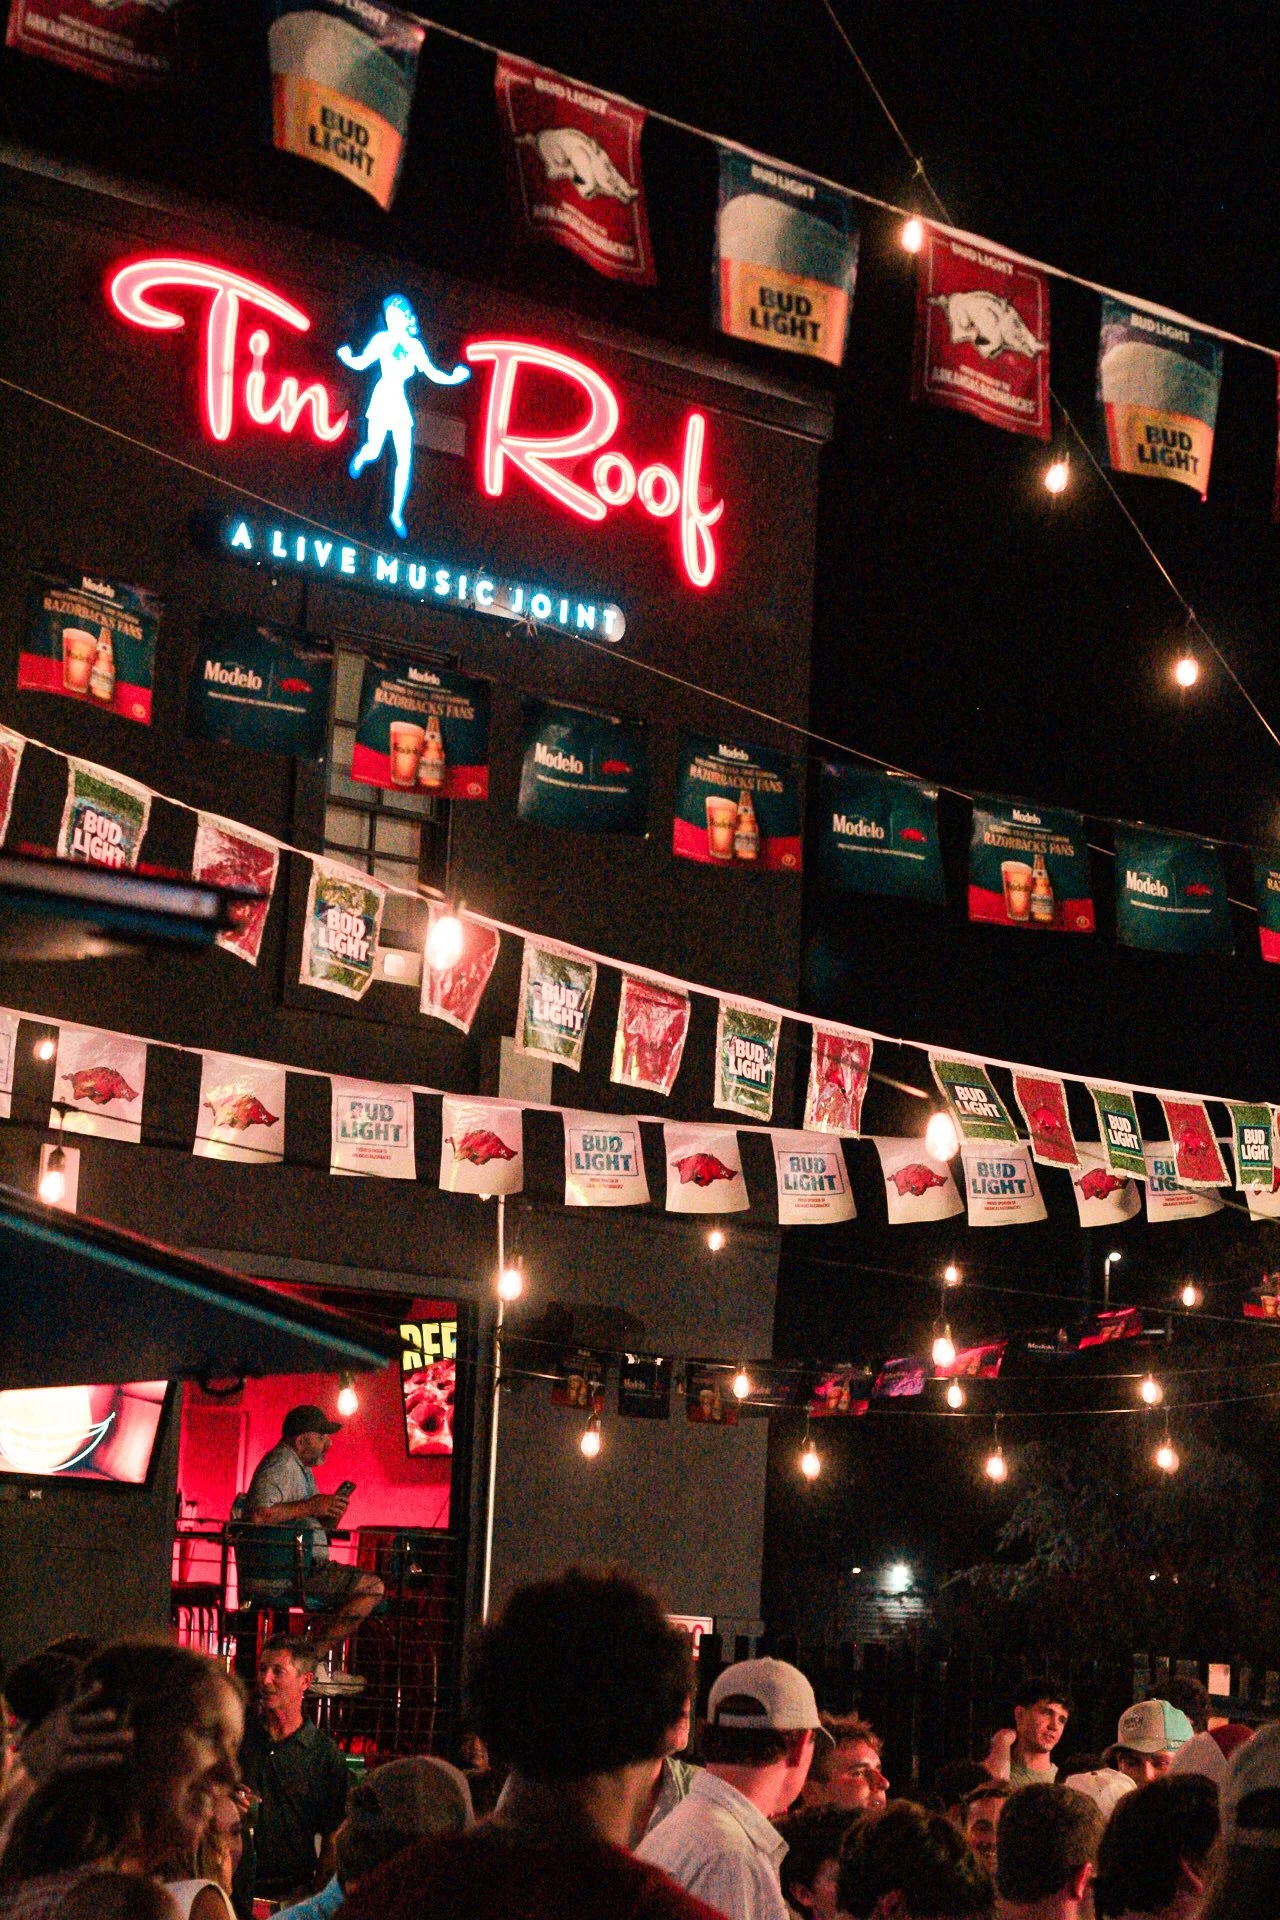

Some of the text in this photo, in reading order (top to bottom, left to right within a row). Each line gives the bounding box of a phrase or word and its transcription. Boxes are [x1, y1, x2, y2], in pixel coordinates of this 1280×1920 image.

[321, 106, 369, 147] BUD
[309, 124, 375, 176] LIGHT
[759, 286, 812, 316] BUD
[750, 308, 820, 342] LIGHT
[1157, 323, 1190, 343] LIGHT
[111, 258, 724, 587] Tin Roof
[1145, 425, 1192, 451] BUD
[1137, 444, 1199, 475] LIGHT
[231, 522, 617, 634] A LIVE MUSIC JOINT
[43, 596, 117, 630] RAZORBACKS
[204, 660, 262, 690] Modelo
[534, 742, 584, 774] Modelo
[83, 809, 122, 845] BUD
[833, 813, 885, 839] Modelo
[72, 827, 126, 868] LIGHT
[984, 831, 1047, 854] RAZORBACKS
[1126, 870, 1169, 898] Modelo
[327, 909, 366, 940] BUD
[318, 926, 369, 961] LIGHT
[541, 981, 581, 1009] BUD
[533, 1000, 583, 1031] LIGHT
[735, 1039, 765, 1063] BUD
[728, 1056, 771, 1083] LIGHT
[954, 1085, 988, 1103] BUD
[350, 1101, 394, 1122] BUD
[954, 1100, 1003, 1118] LIGHT
[341, 1120, 403, 1142] LIGHT
[1107, 1114, 1132, 1133] BUD
[1243, 1128, 1265, 1144] BUD
[582, 1134, 623, 1153] BUD
[1108, 1128, 1140, 1150] LIGHT
[574, 1152, 632, 1171] LIGHT
[789, 1157, 826, 1174] BUD
[1240, 1144, 1270, 1161] LIGHT
[976, 1162, 1016, 1178] BUD
[1153, 1160, 1177, 1176] BU
[784, 1173, 836, 1191] LIGHT
[972, 1178, 1026, 1194] LIGHT
